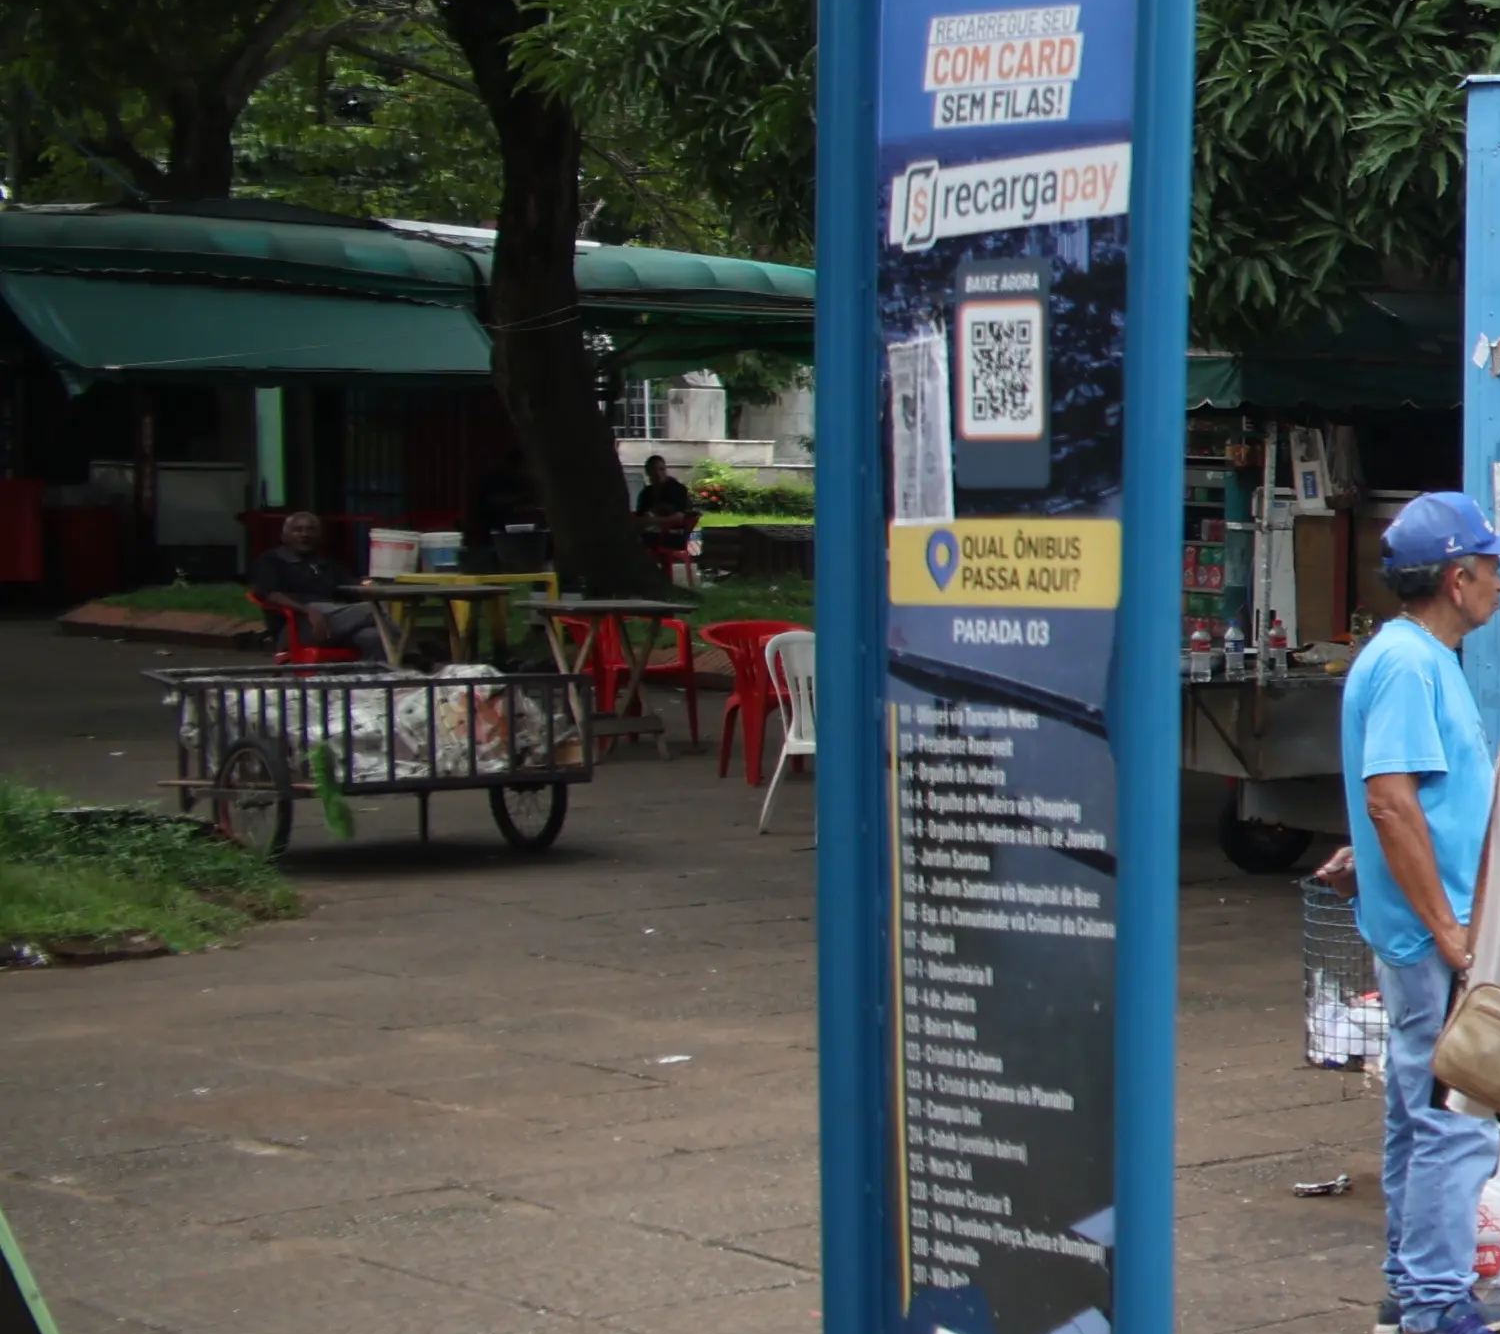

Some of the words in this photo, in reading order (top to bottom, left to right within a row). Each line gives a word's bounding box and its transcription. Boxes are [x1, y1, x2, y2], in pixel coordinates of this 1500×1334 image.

[936, 12, 1037, 44] RECARREGUE
[1042, 9, 1075, 33] SEU
[933, 44, 991, 85] COM
[997, 37, 1076, 80] CARD
[942, 91, 986, 124] SEM
[992, 85, 1064, 119] FILAS!
[943, 162, 1119, 221] recargapay
[965, 274, 999, 294] BAIXE
[1000, 272, 1040, 291] AGORA
[962, 535, 1009, 560] QUAL
[1014, 528, 1082, 560] ÔNIBUS
[961, 566, 1021, 591] PASSA
[1026, 567, 1082, 594] AQUI?
[953, 618, 1024, 646] PARADA
[1027, 620, 1050, 647] 03
[1033, 797, 1082, 824] Shopping
